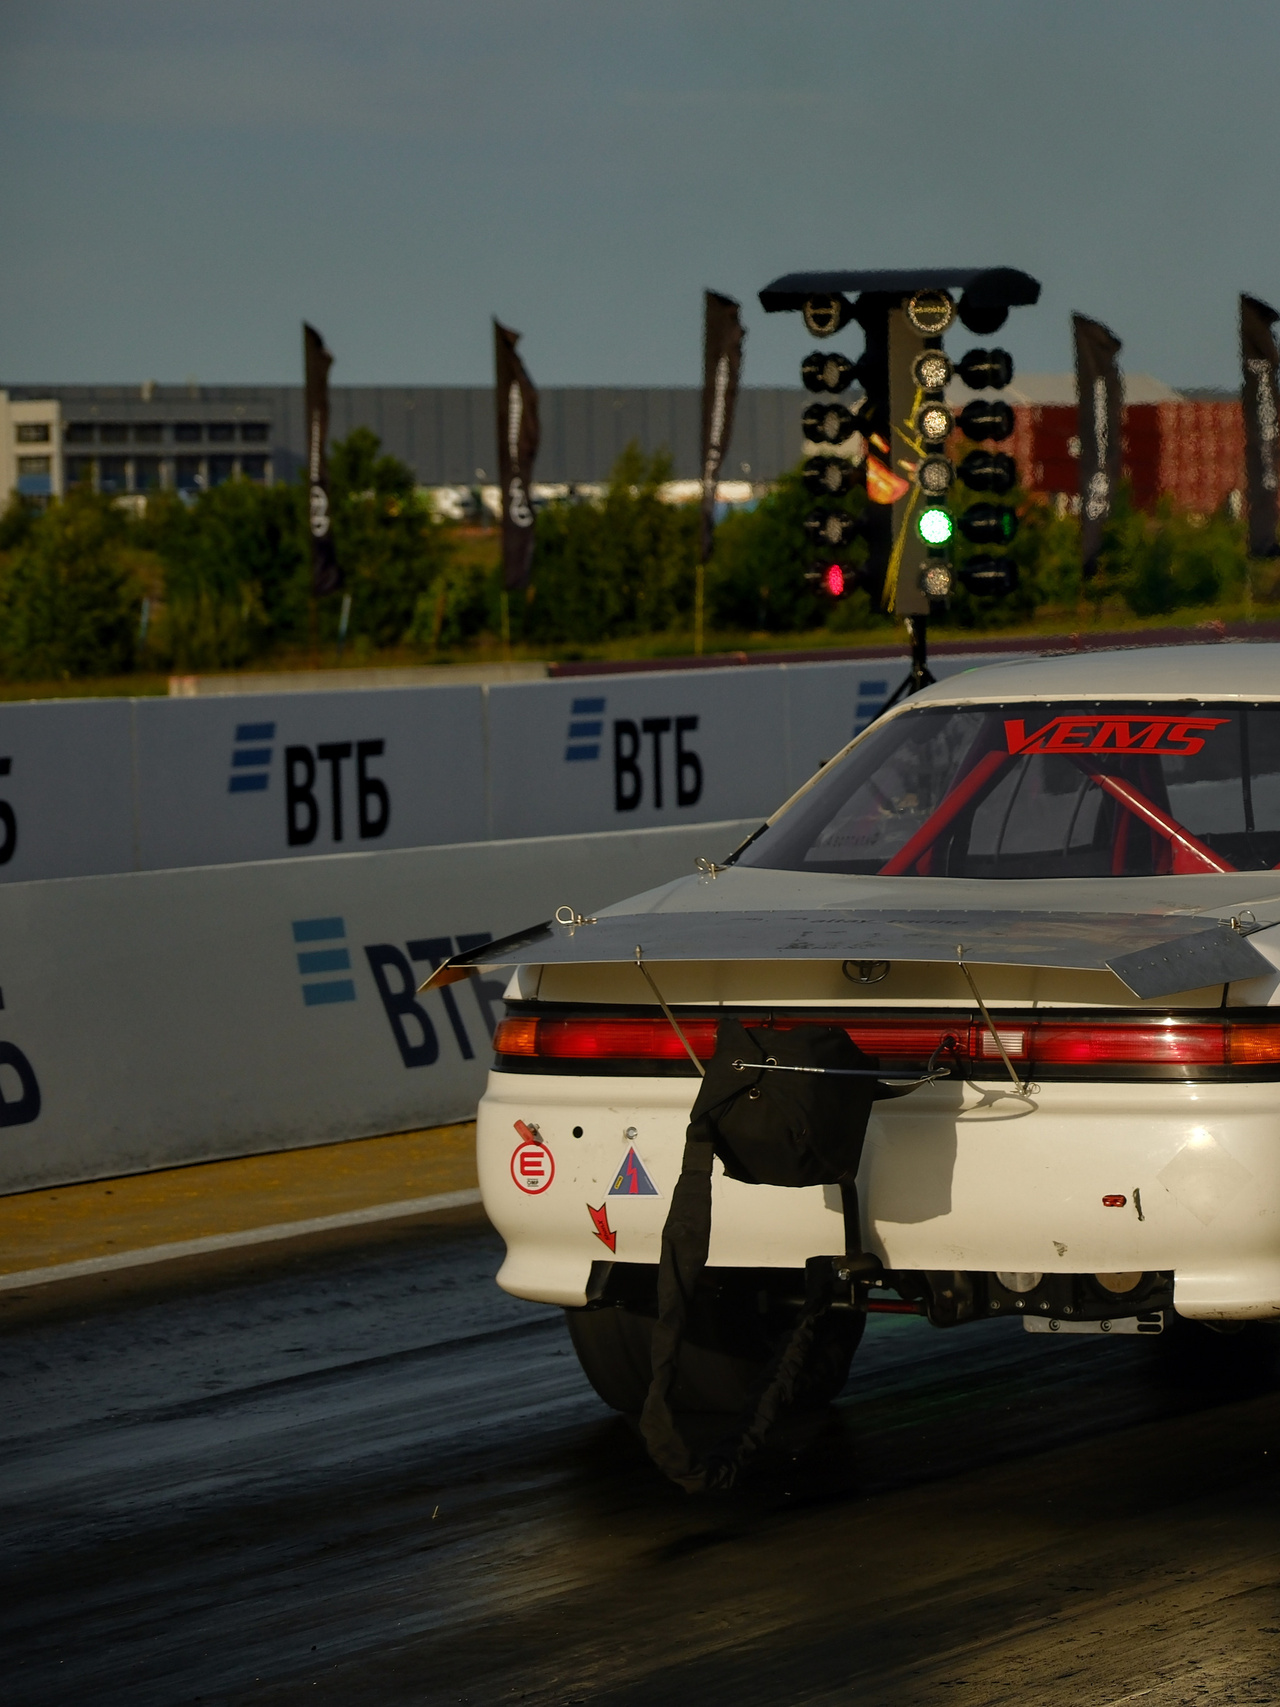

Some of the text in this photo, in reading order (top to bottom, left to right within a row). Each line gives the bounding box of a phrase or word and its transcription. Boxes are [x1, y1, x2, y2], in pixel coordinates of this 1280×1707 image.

[615, 716, 703, 811] ВТБ
[1004, 715, 1231, 756] VEMS
[285, 739, 390, 847] ВТБ
[520, 1152, 545, 1176] E
